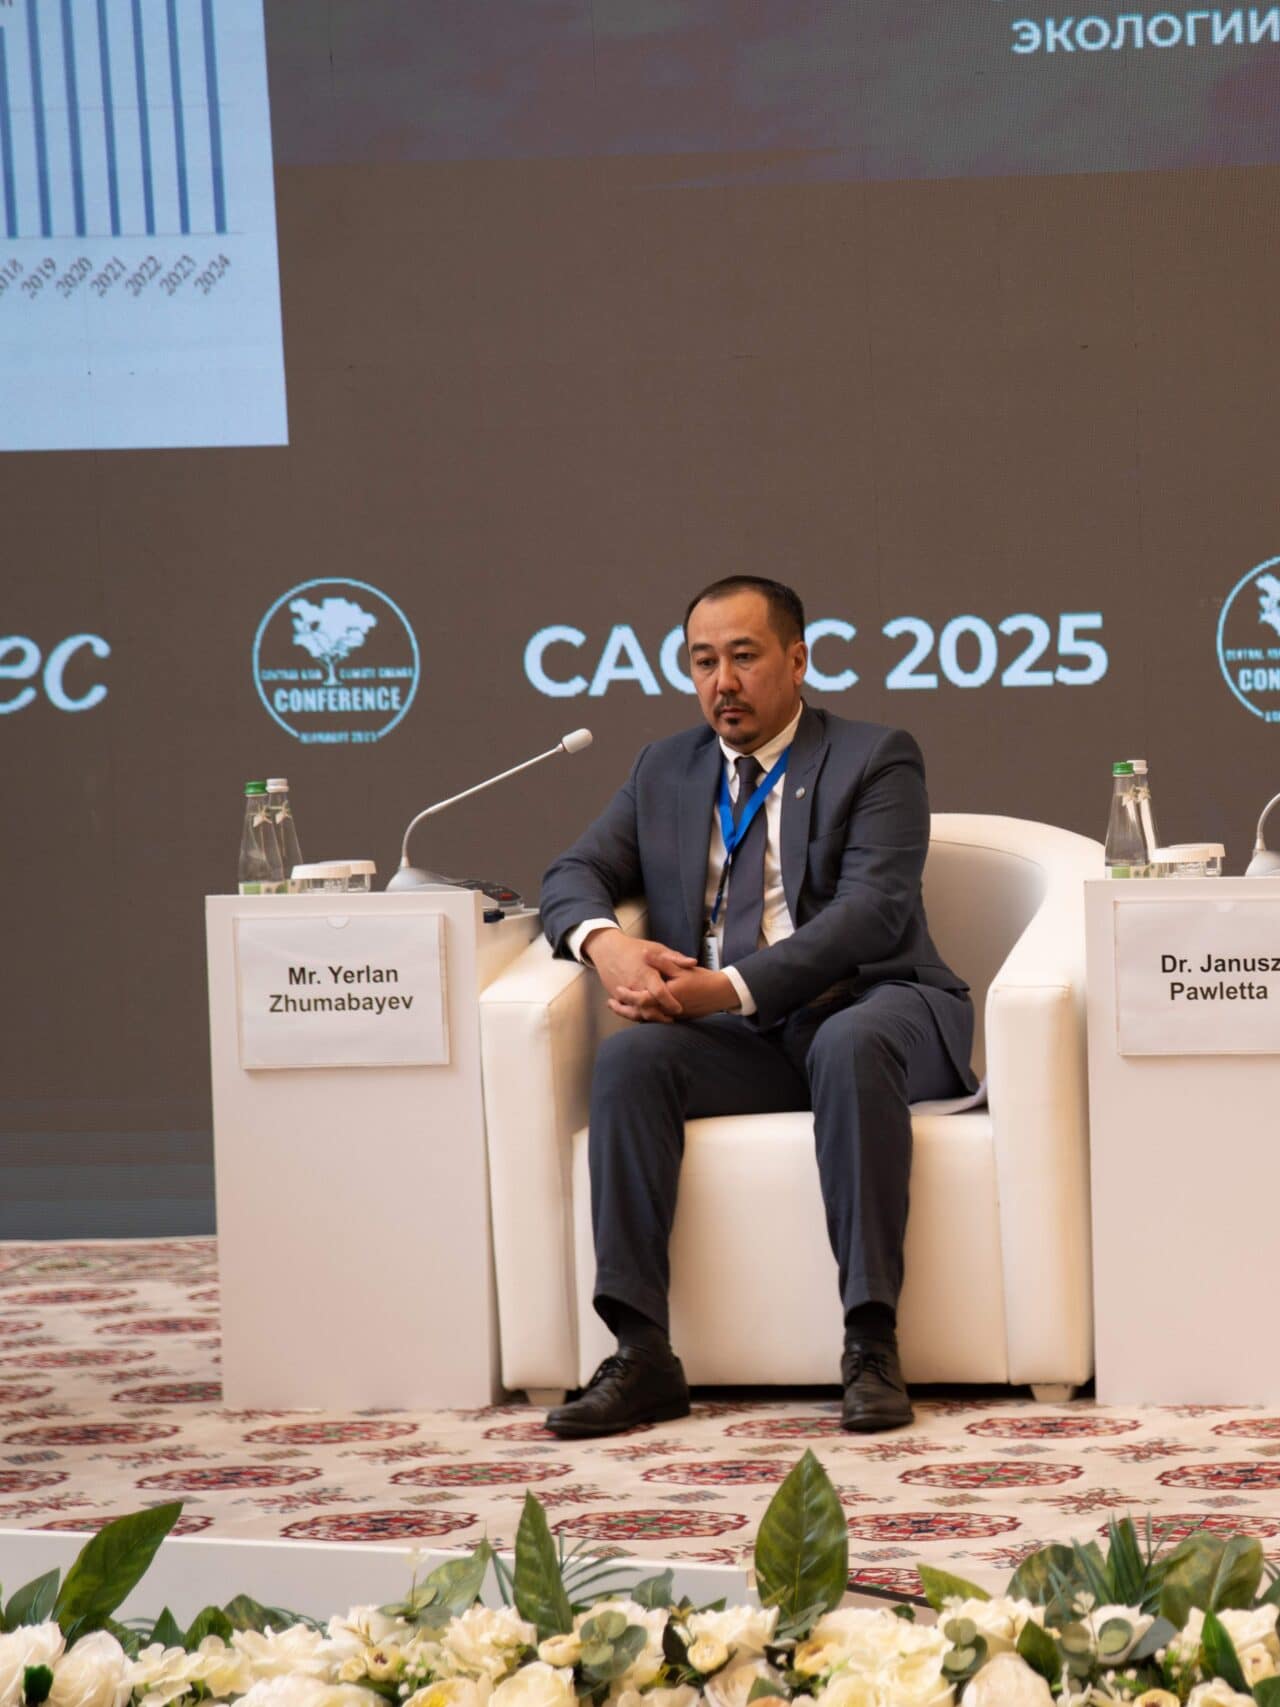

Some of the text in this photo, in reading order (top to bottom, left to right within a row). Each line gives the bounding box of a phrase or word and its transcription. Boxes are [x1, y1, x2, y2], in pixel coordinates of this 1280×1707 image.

[1011, 6, 1280, 53] ЭКОЛОГИИ
[21, 256, 56, 299] 2019
[56, 256, 92, 298] 2020
[90, 255, 126, 297] 2021
[125, 254, 161, 297] 2022
[194, 253, 230, 295] 2024
[882, 611, 1108, 691] 2025
[274, 686, 401, 713] CONFERENCE
[288, 965, 399, 985] Mr. Yerlan
[1161, 954, 1192, 973] Dr.
[269, 993, 414, 1015] Zhumabayev
[1170, 981, 1268, 1001] Pawletta
